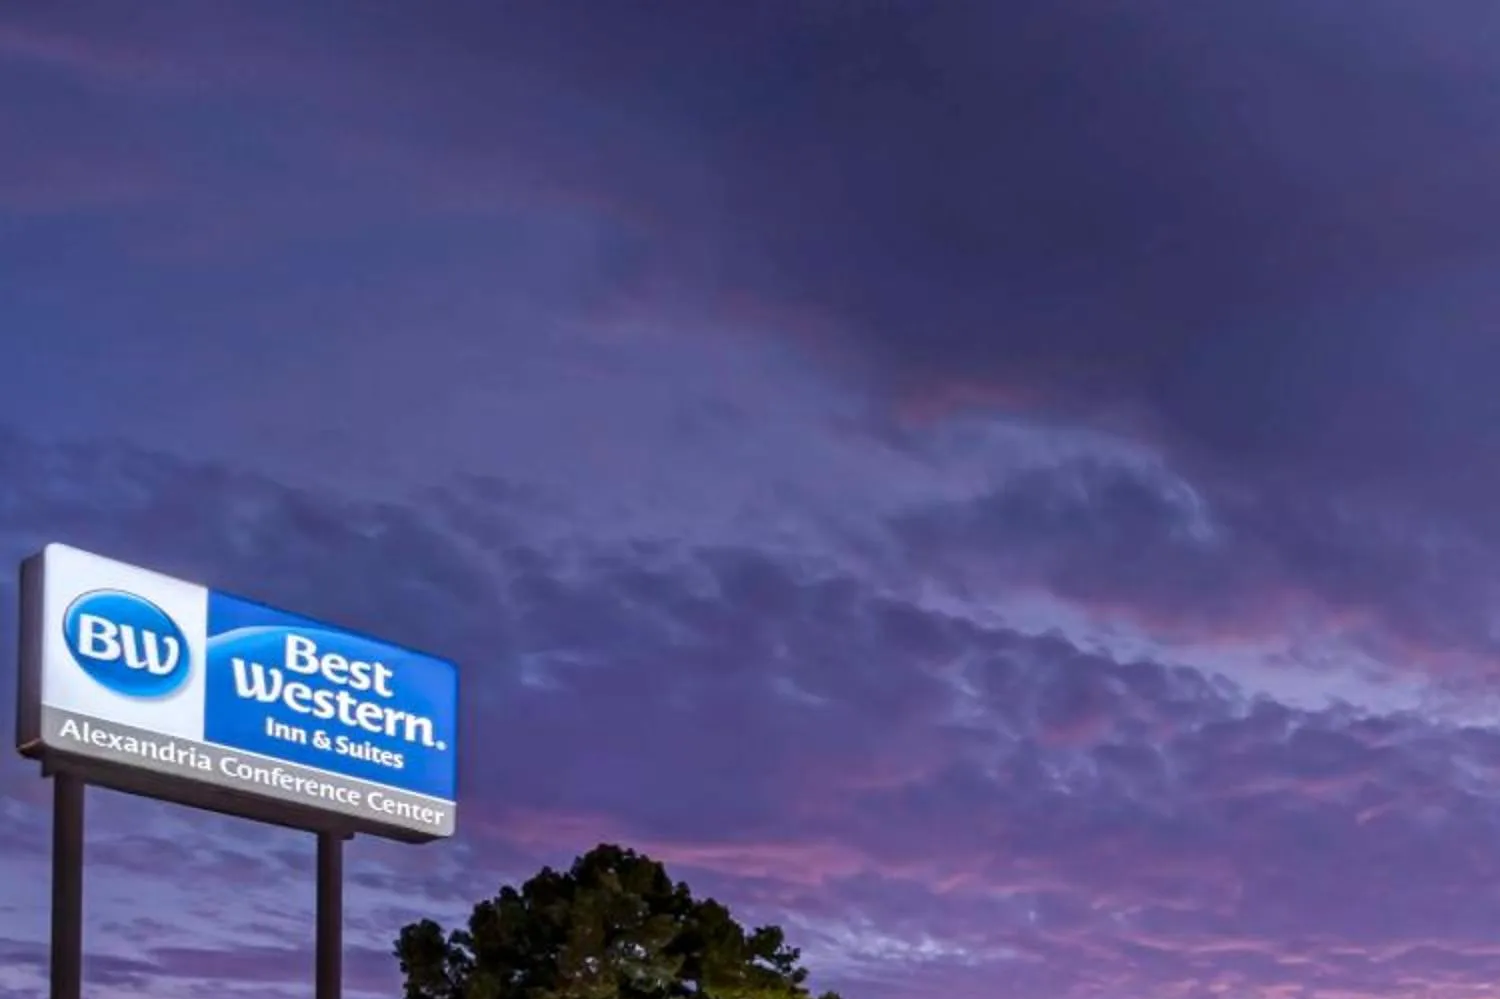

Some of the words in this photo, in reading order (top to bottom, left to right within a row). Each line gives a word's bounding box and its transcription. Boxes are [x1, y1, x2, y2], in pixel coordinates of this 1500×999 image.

[79, 613, 180, 676] BW
[285, 633, 394, 698] Best
[59, 718, 212, 772] Alexandria
[219, 756, 361, 806] Conference
[367, 791, 445, 826] Center
[265, 716, 308, 746] Inn
[312, 729, 333, 751] &
[335, 735, 405, 769] Suites
